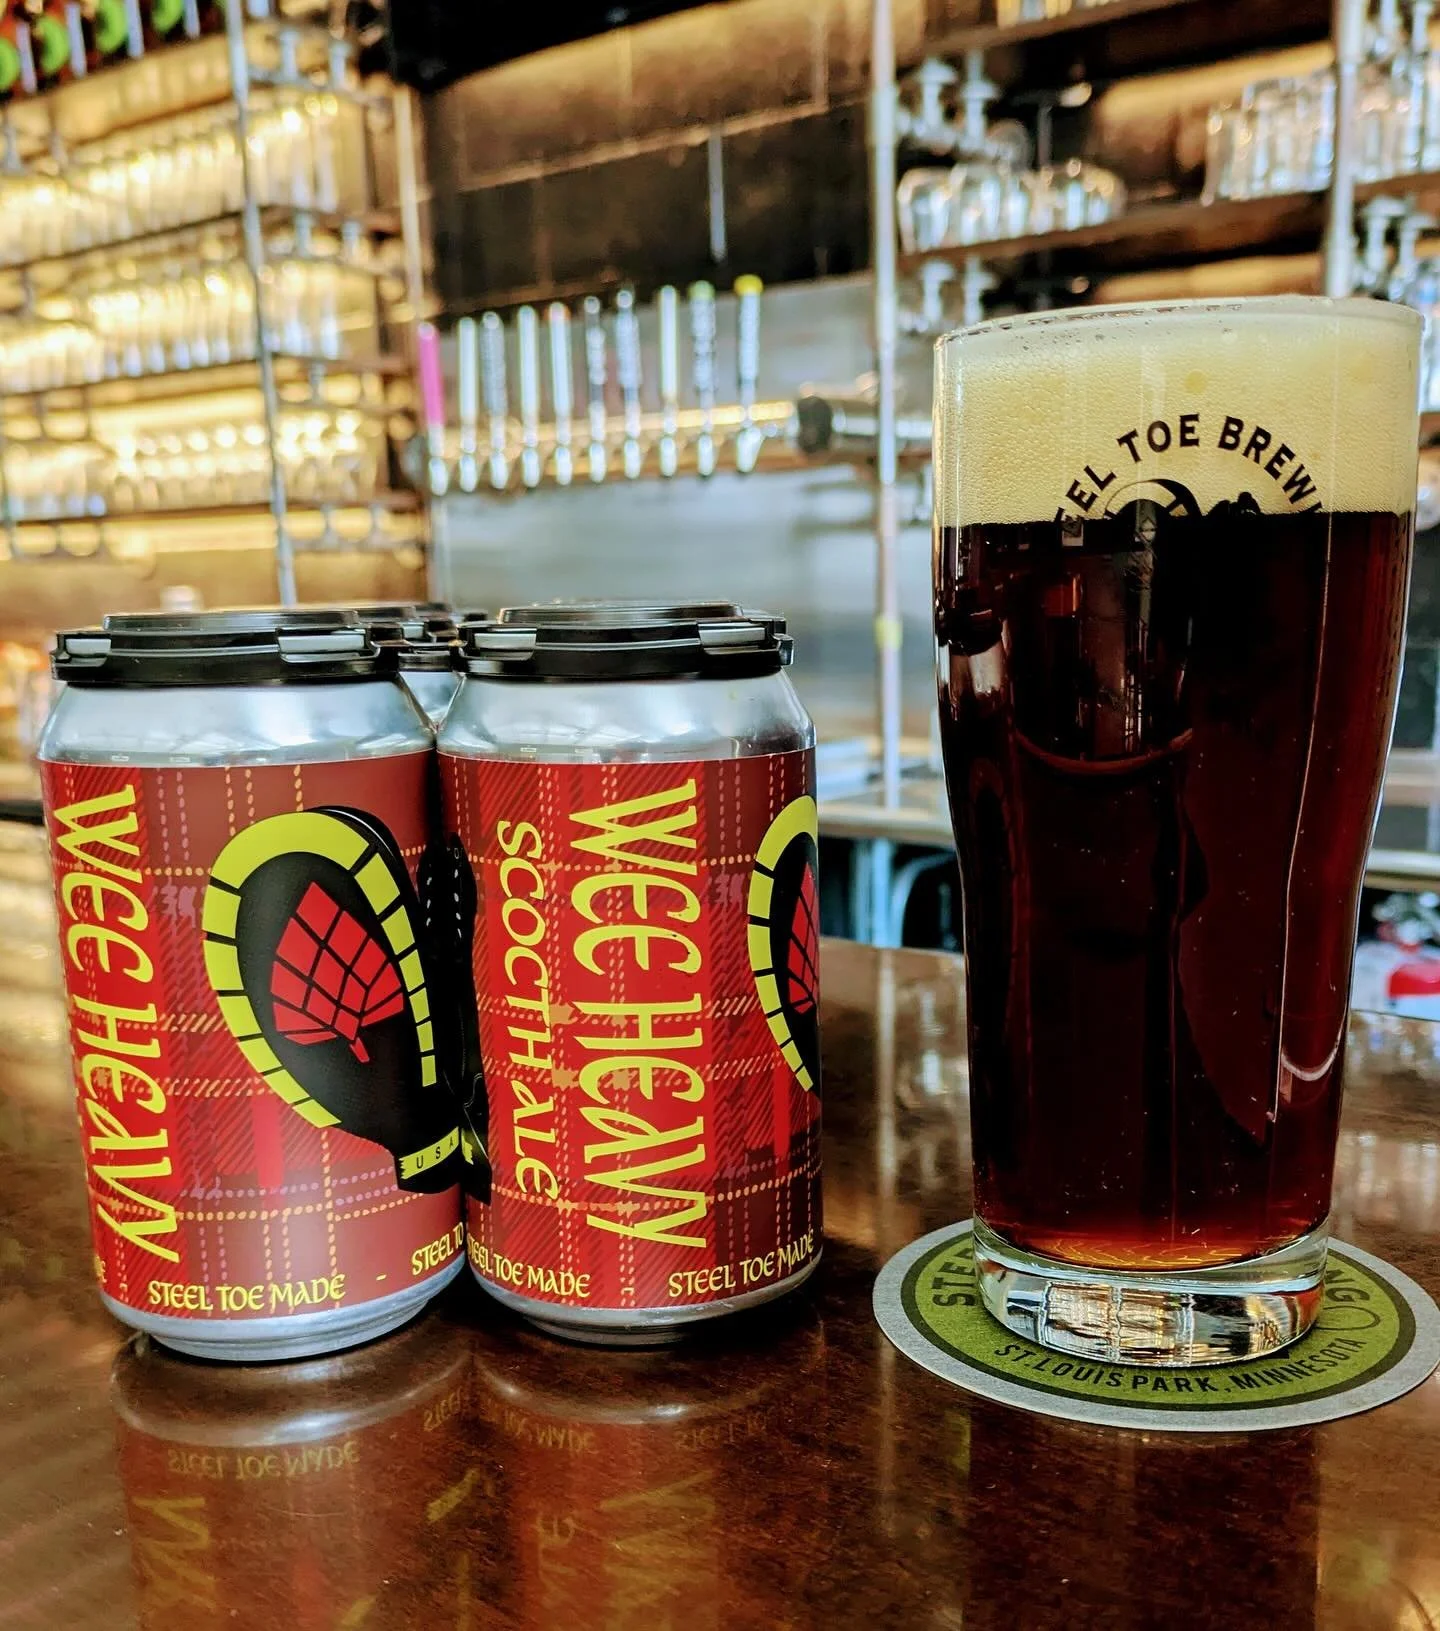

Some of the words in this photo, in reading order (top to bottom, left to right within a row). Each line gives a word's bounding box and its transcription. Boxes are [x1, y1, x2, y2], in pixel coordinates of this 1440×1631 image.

[1116, 413, 1200, 463] TOE
[1218, 415, 1323, 513] BREW
[53, 785, 154, 982] WEE
[569, 778, 702, 975] WEE
[72, 995, 179, 1262] HEAVY
[509, 1080, 560, 1200] ALE
[572, 993, 708, 1248] HEAVY
[412, 1233, 454, 1276] STEEL
[453, 1222, 463, 1250] TO
[494, 1253, 524, 1286] TOE
[528, 1265, 591, 1298] MADE
[668, 1265, 736, 1298] STEEL
[740, 1251, 775, 1285] TOE
[778, 1229, 814, 1269] MADE
[931, 1247, 976, 1307] STE
[149, 1280, 213, 1311] STEEL
[216, 1284, 265, 1311] TOE
[271, 1274, 346, 1308] MADE
[1232, 1337, 1367, 1389] MINNESOTA
